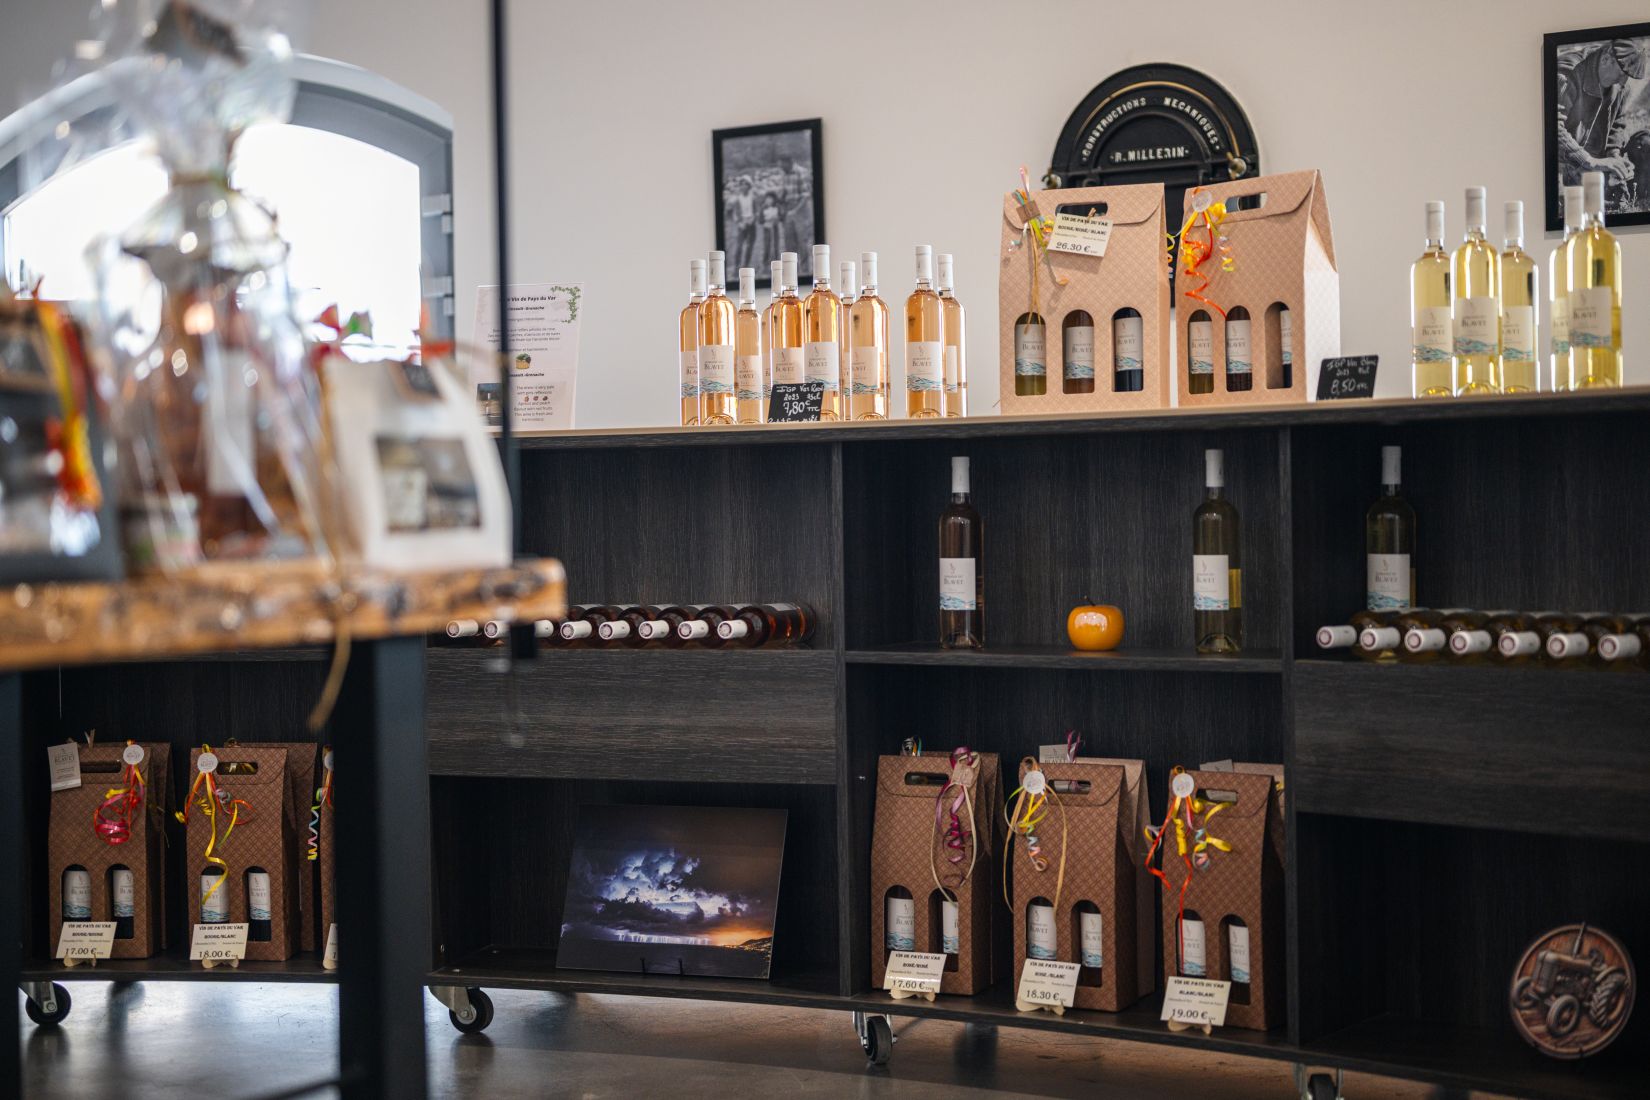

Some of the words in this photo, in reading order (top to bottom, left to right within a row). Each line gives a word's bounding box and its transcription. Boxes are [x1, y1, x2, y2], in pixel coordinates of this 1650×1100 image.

[1082, 97, 1147, 157] CONSTRUCTIONS
[1163, 97, 1219, 144] MECANIQUES
[1056, 241, 1082, 252] 26.30
[1083, 244, 1091, 253] €
[783, 401, 805, 417] 7,80
[65, 947, 89, 956] 17.00
[90, 947, 97, 955] €
[198, 950, 223, 959] 18.00
[225, 950, 232, 959] €
[892, 979, 917, 989] 17.60
[918, 981, 926, 990] €
[1026, 989, 1051, 1000] 18.30
[1053, 992, 1060, 1001] €
[1171, 1007, 1199, 1019] 19.00
[1201, 1011, 1209, 1020] €
